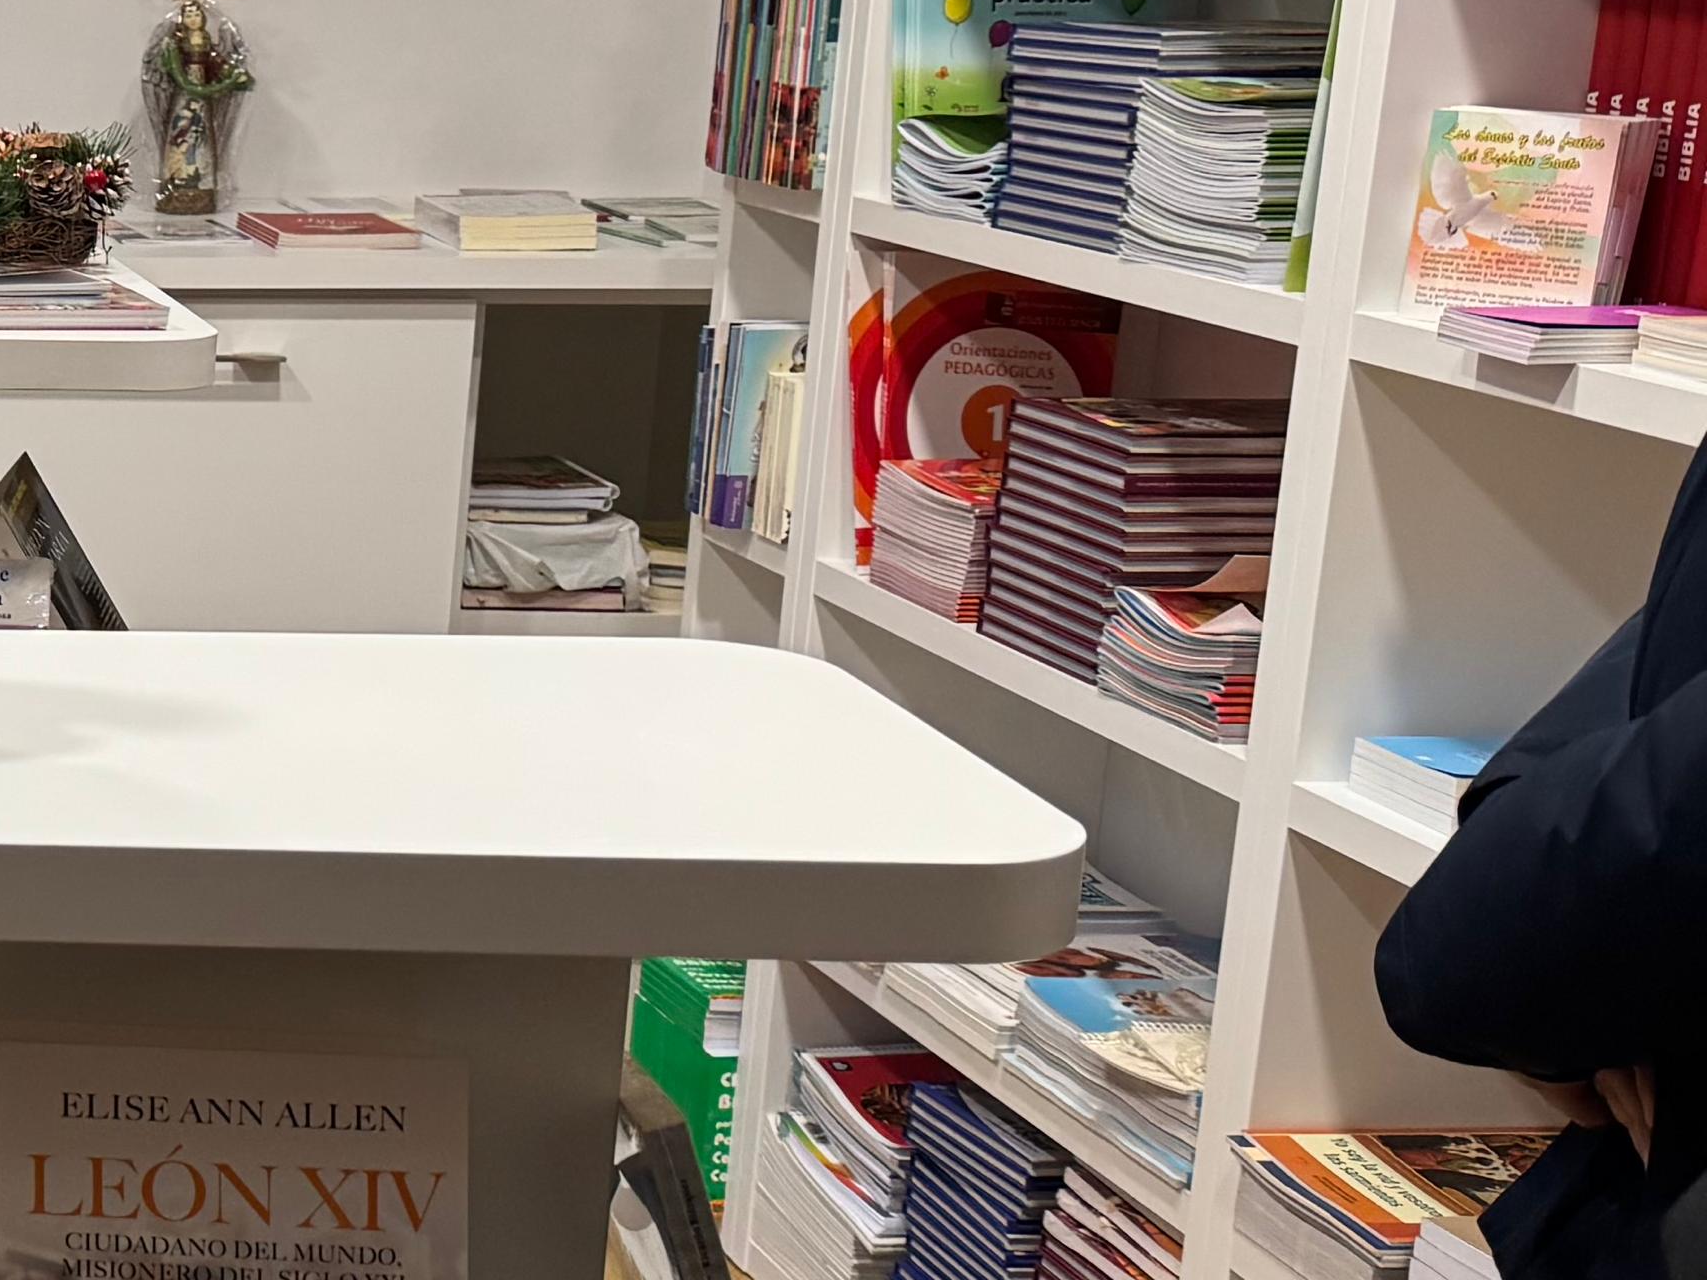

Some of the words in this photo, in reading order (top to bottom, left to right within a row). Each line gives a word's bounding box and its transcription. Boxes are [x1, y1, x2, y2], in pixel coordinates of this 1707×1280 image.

[1678, 103, 1701, 182] BIBLIA
[944, 360, 1054, 380] PEDAGÓGICAS
[950, 342, 1052, 360] Orientaciones
[61, 1091, 171, 1122] ELISE
[179, 1098, 265, 1127] ANN
[275, 1102, 407, 1132] ALLEN
[26, 1143, 279, 1227] LEÓN
[296, 1166, 448, 1234] XIV
